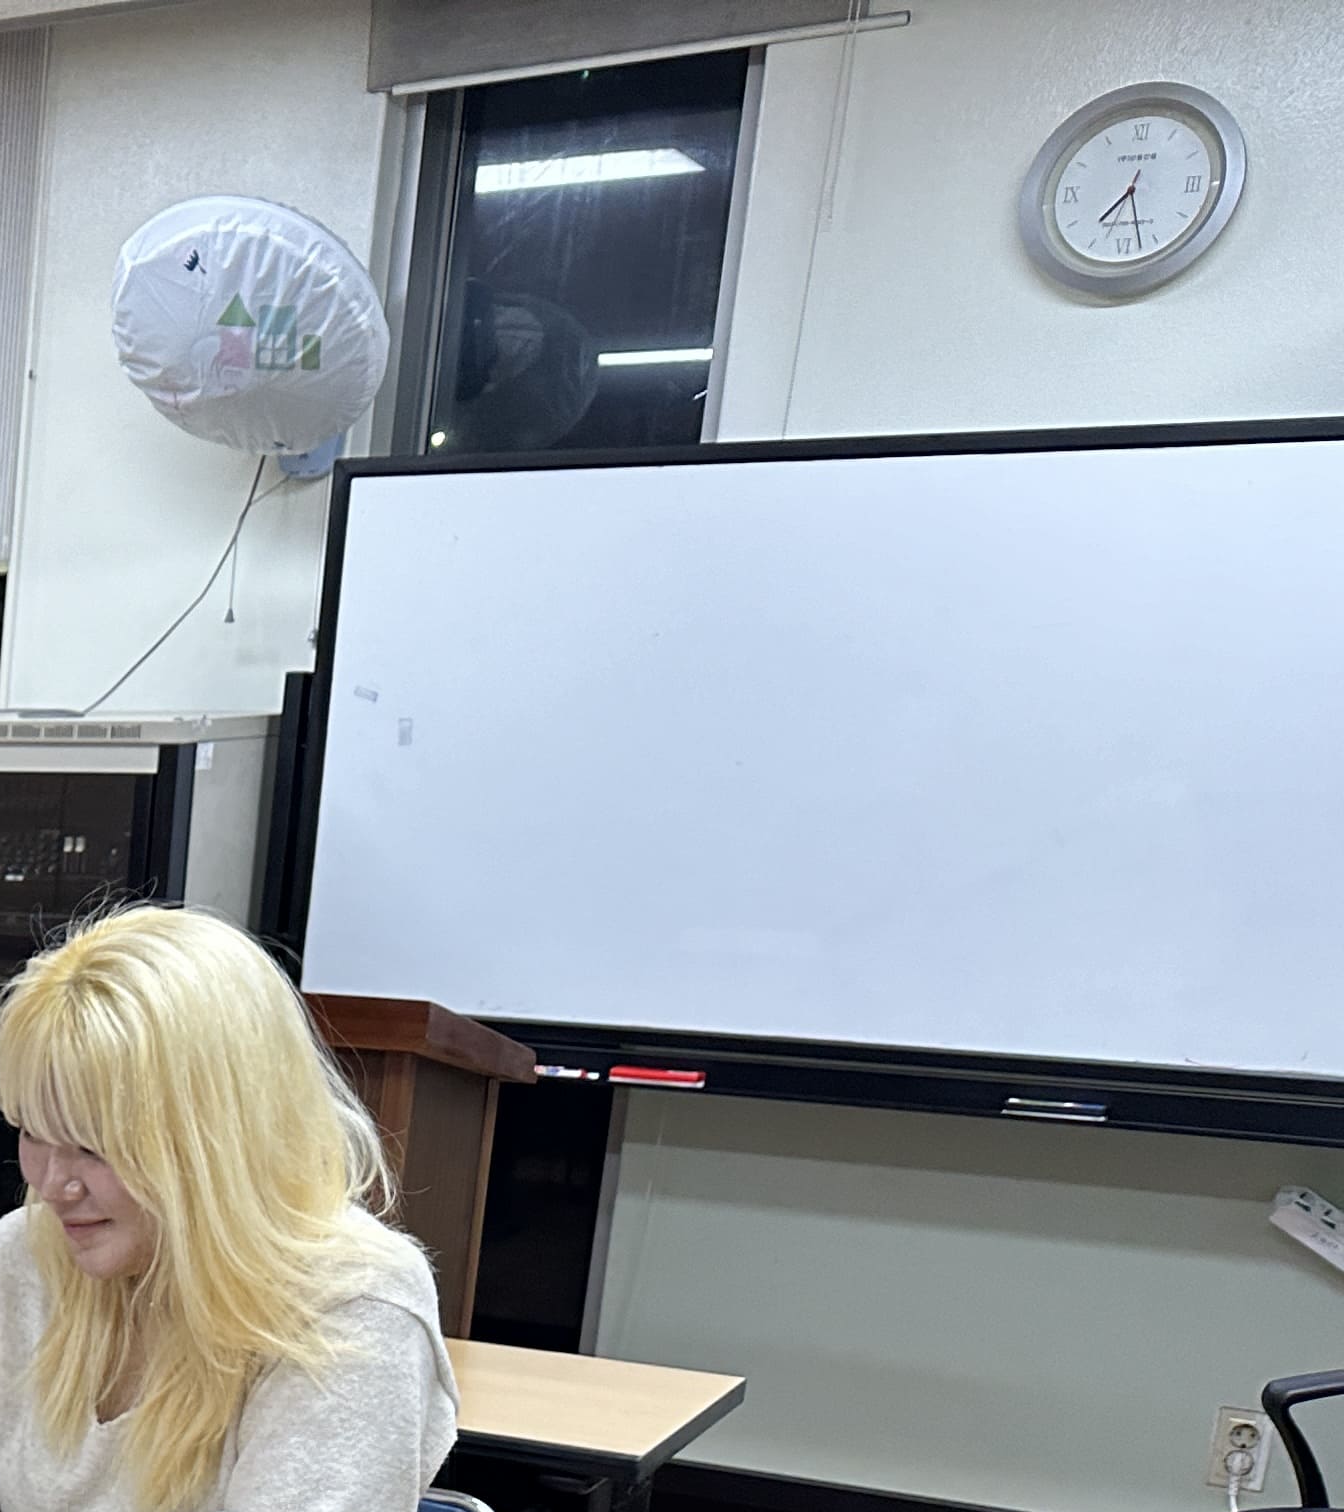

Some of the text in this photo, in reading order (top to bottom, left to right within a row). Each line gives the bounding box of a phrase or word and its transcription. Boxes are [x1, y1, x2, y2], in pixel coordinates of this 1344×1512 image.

[1184, 175, 1202, 193] III
[1063, 186, 1081, 203] IX
[1115, 237, 1132, 254] VI
